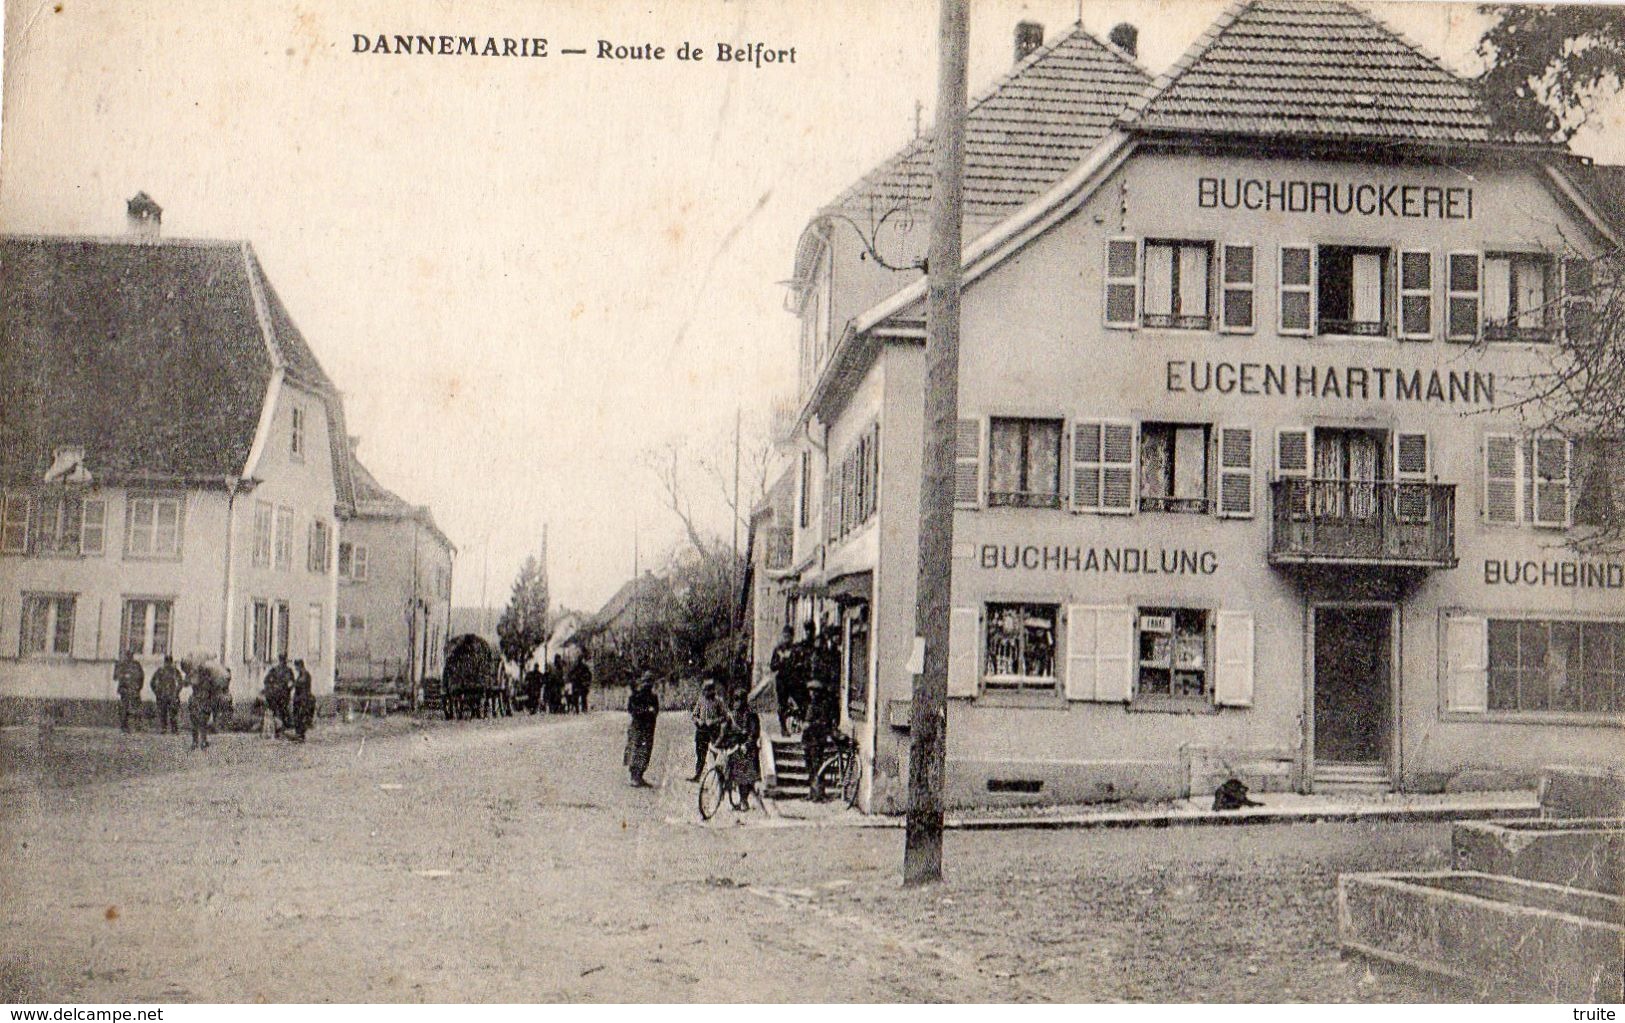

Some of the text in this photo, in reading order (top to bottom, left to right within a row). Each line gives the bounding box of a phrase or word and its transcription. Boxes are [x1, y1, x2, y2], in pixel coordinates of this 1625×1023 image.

[1198, 177, 1474, 219] BUCHDRUCKEREI
[1167, 361, 1496, 405] EUGEN HARTMANN
[981, 544, 1219, 575] BUCHHANDLUNG
[1484, 559, 1625, 588] BUCHBIND
